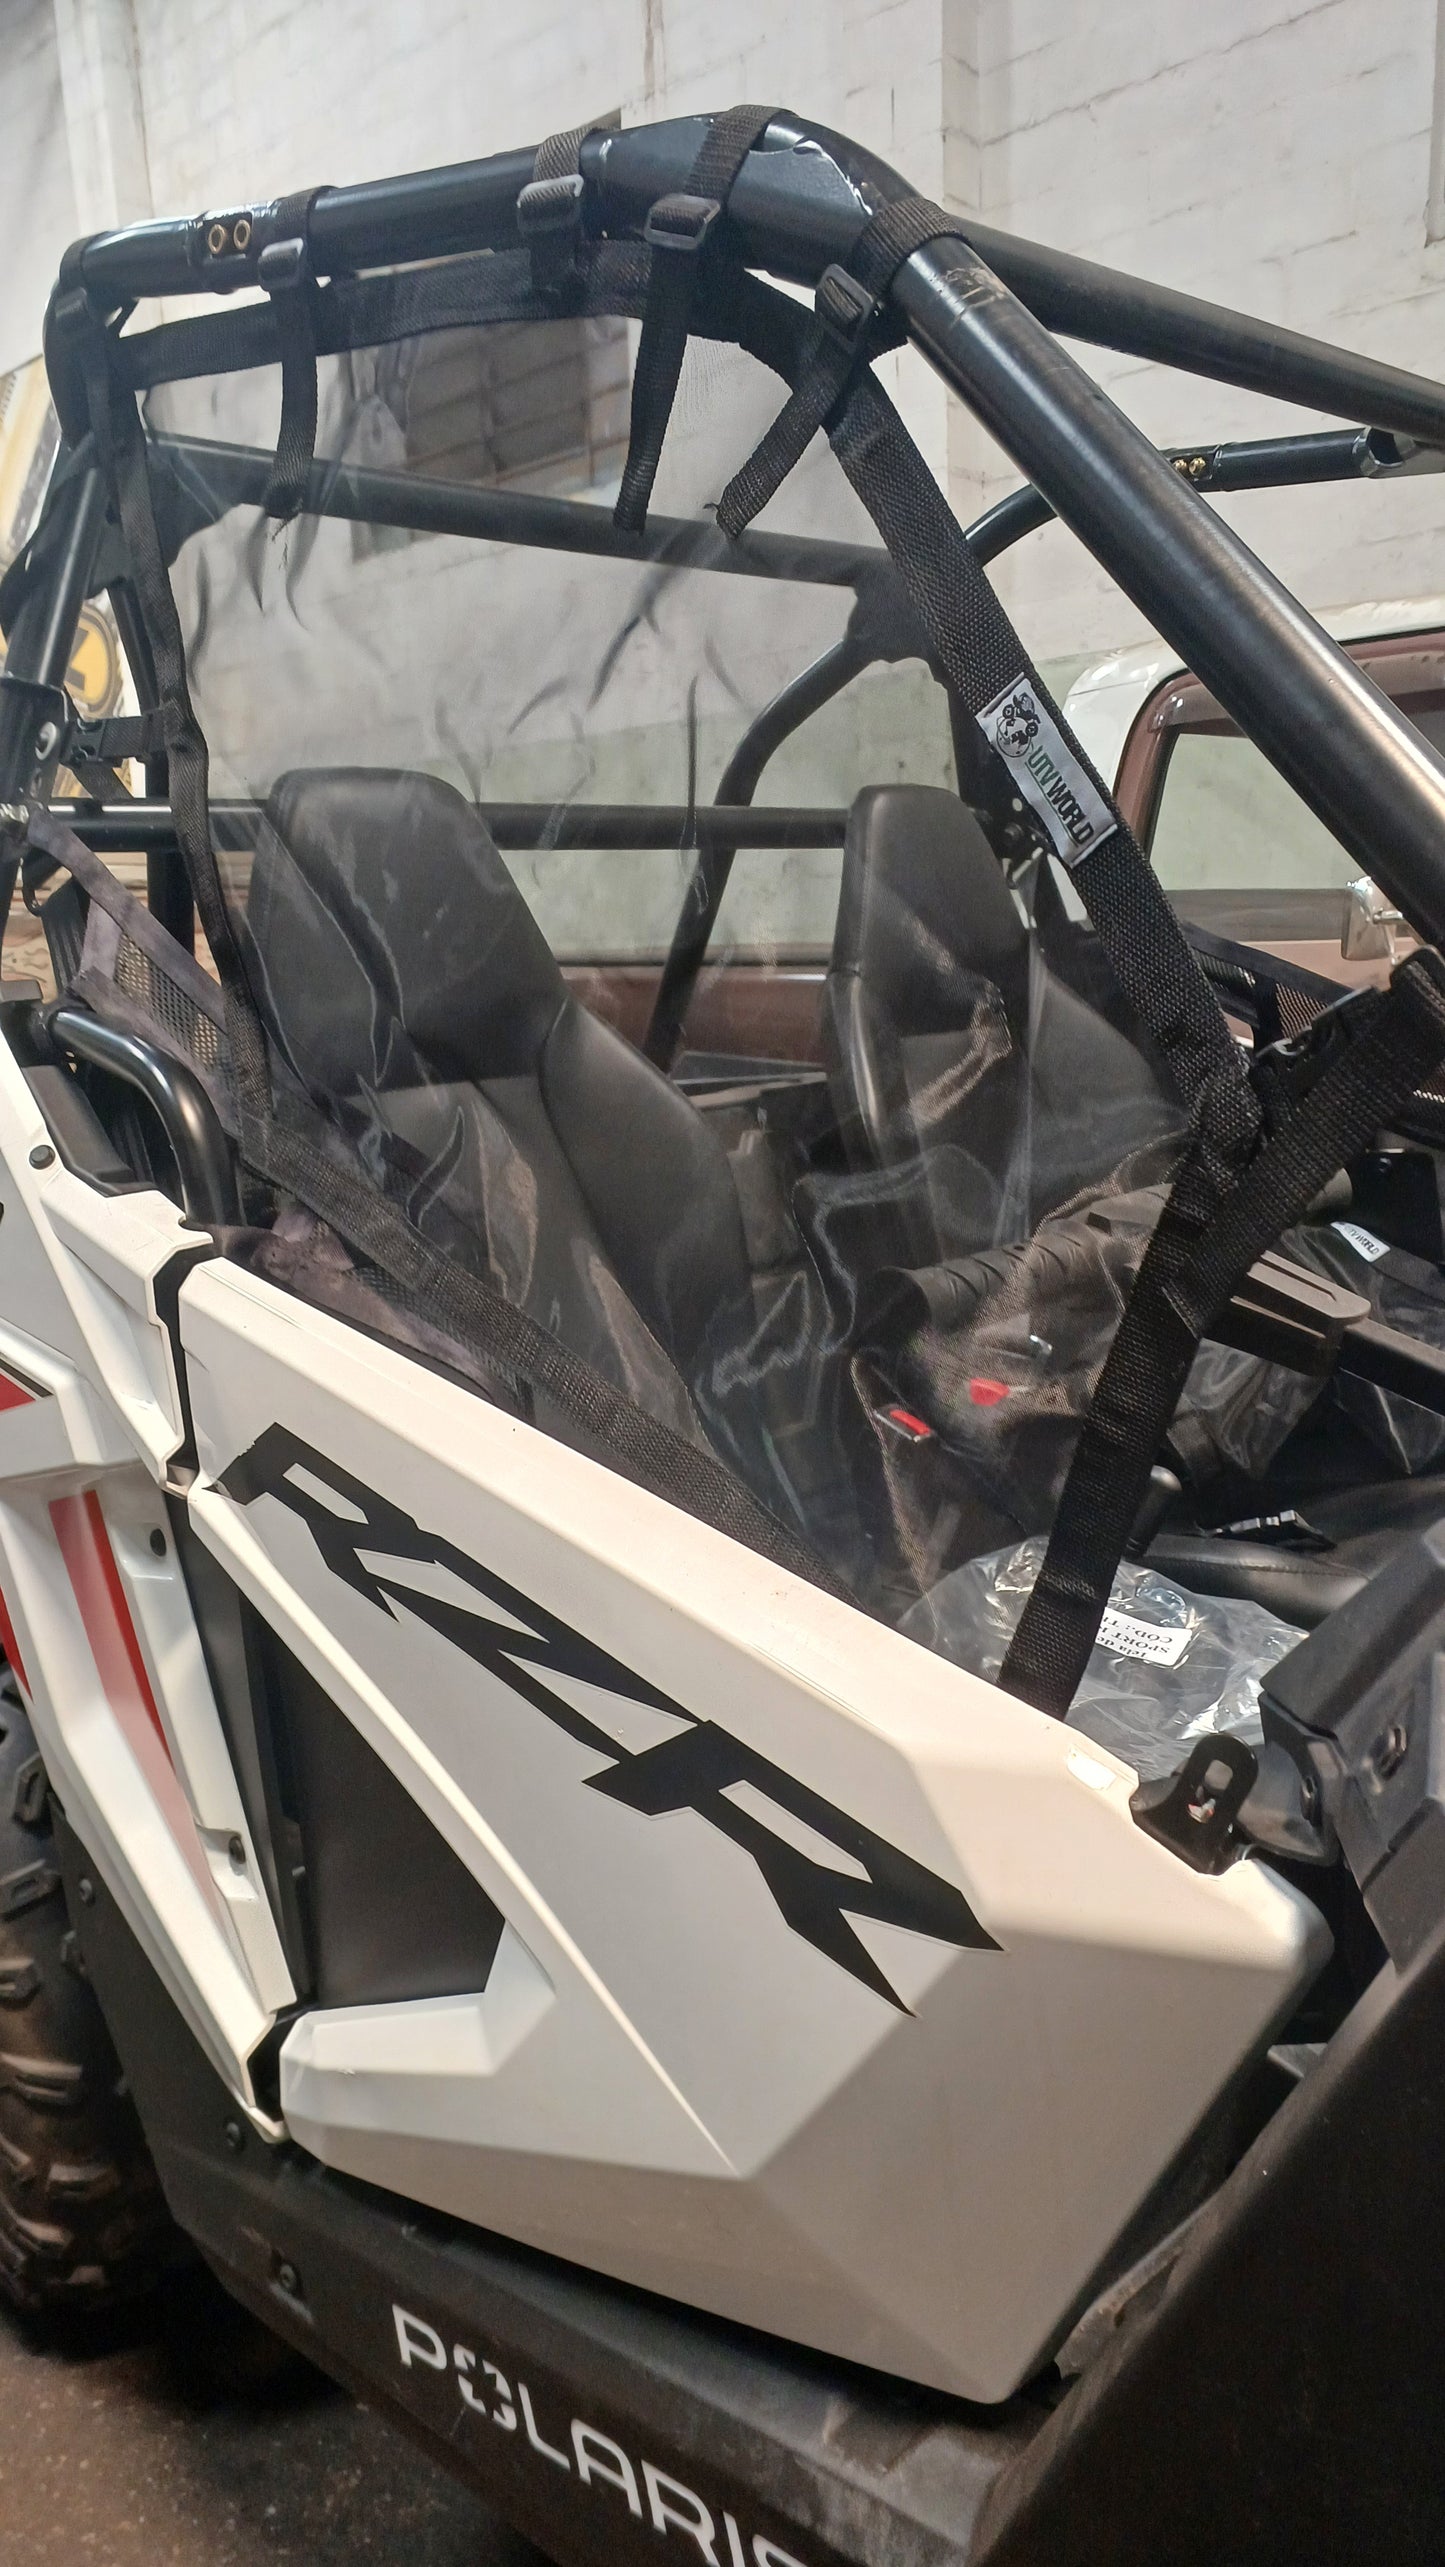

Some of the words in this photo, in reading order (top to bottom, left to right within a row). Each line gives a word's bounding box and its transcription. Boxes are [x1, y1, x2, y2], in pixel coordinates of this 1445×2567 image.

[1097, 1636, 1115, 1646] de
[1111, 1632, 1170, 1653] SPORT
[202, 1422, 1004, 2017] RZR
